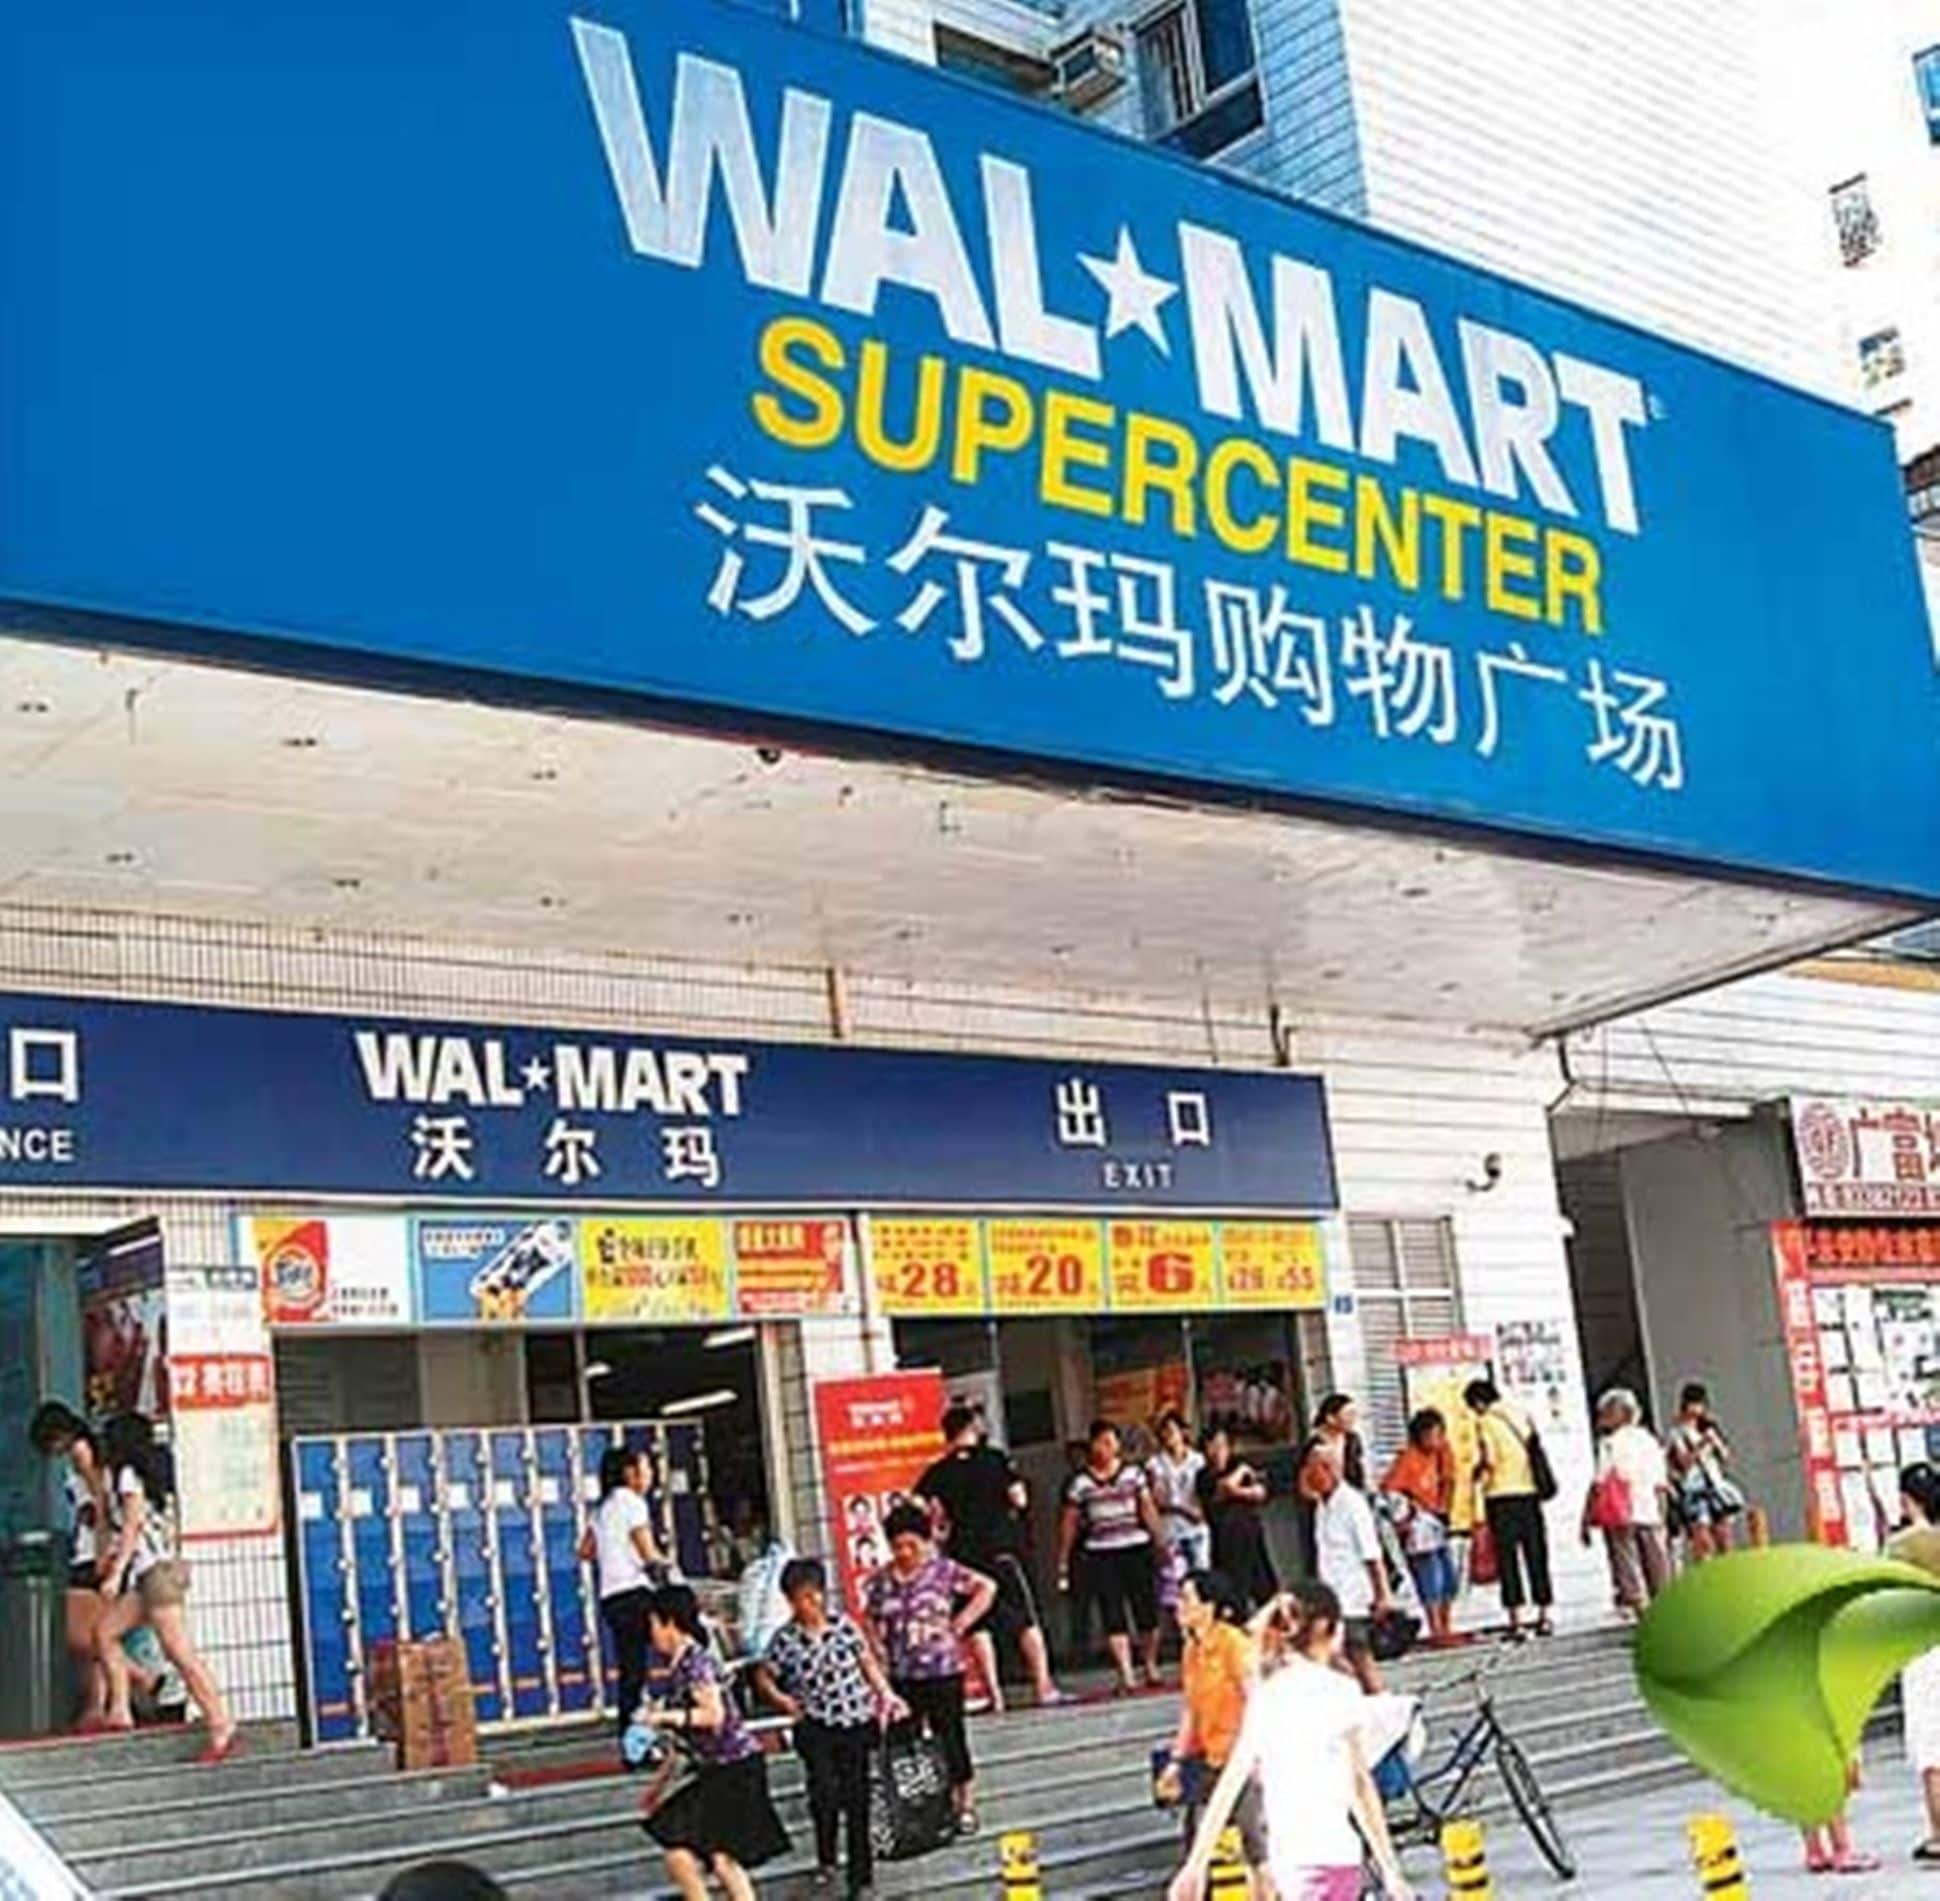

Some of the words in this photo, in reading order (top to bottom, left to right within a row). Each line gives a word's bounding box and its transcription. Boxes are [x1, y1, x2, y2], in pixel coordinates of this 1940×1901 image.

[752, 317, 1603, 636] SUPERCENTER
[693, 463, 1687, 791] 沃尔玛购物广场
[1055, 1076, 1211, 1147] 出口
[412, 1115, 721, 1188] 沃尔玛
[1103, 1161, 1171, 1189] EXIT
[901, 1262, 959, 1298] 28
[1027, 1253, 1083, 1296] 20
[1147, 1253, 1194, 1294] 6
